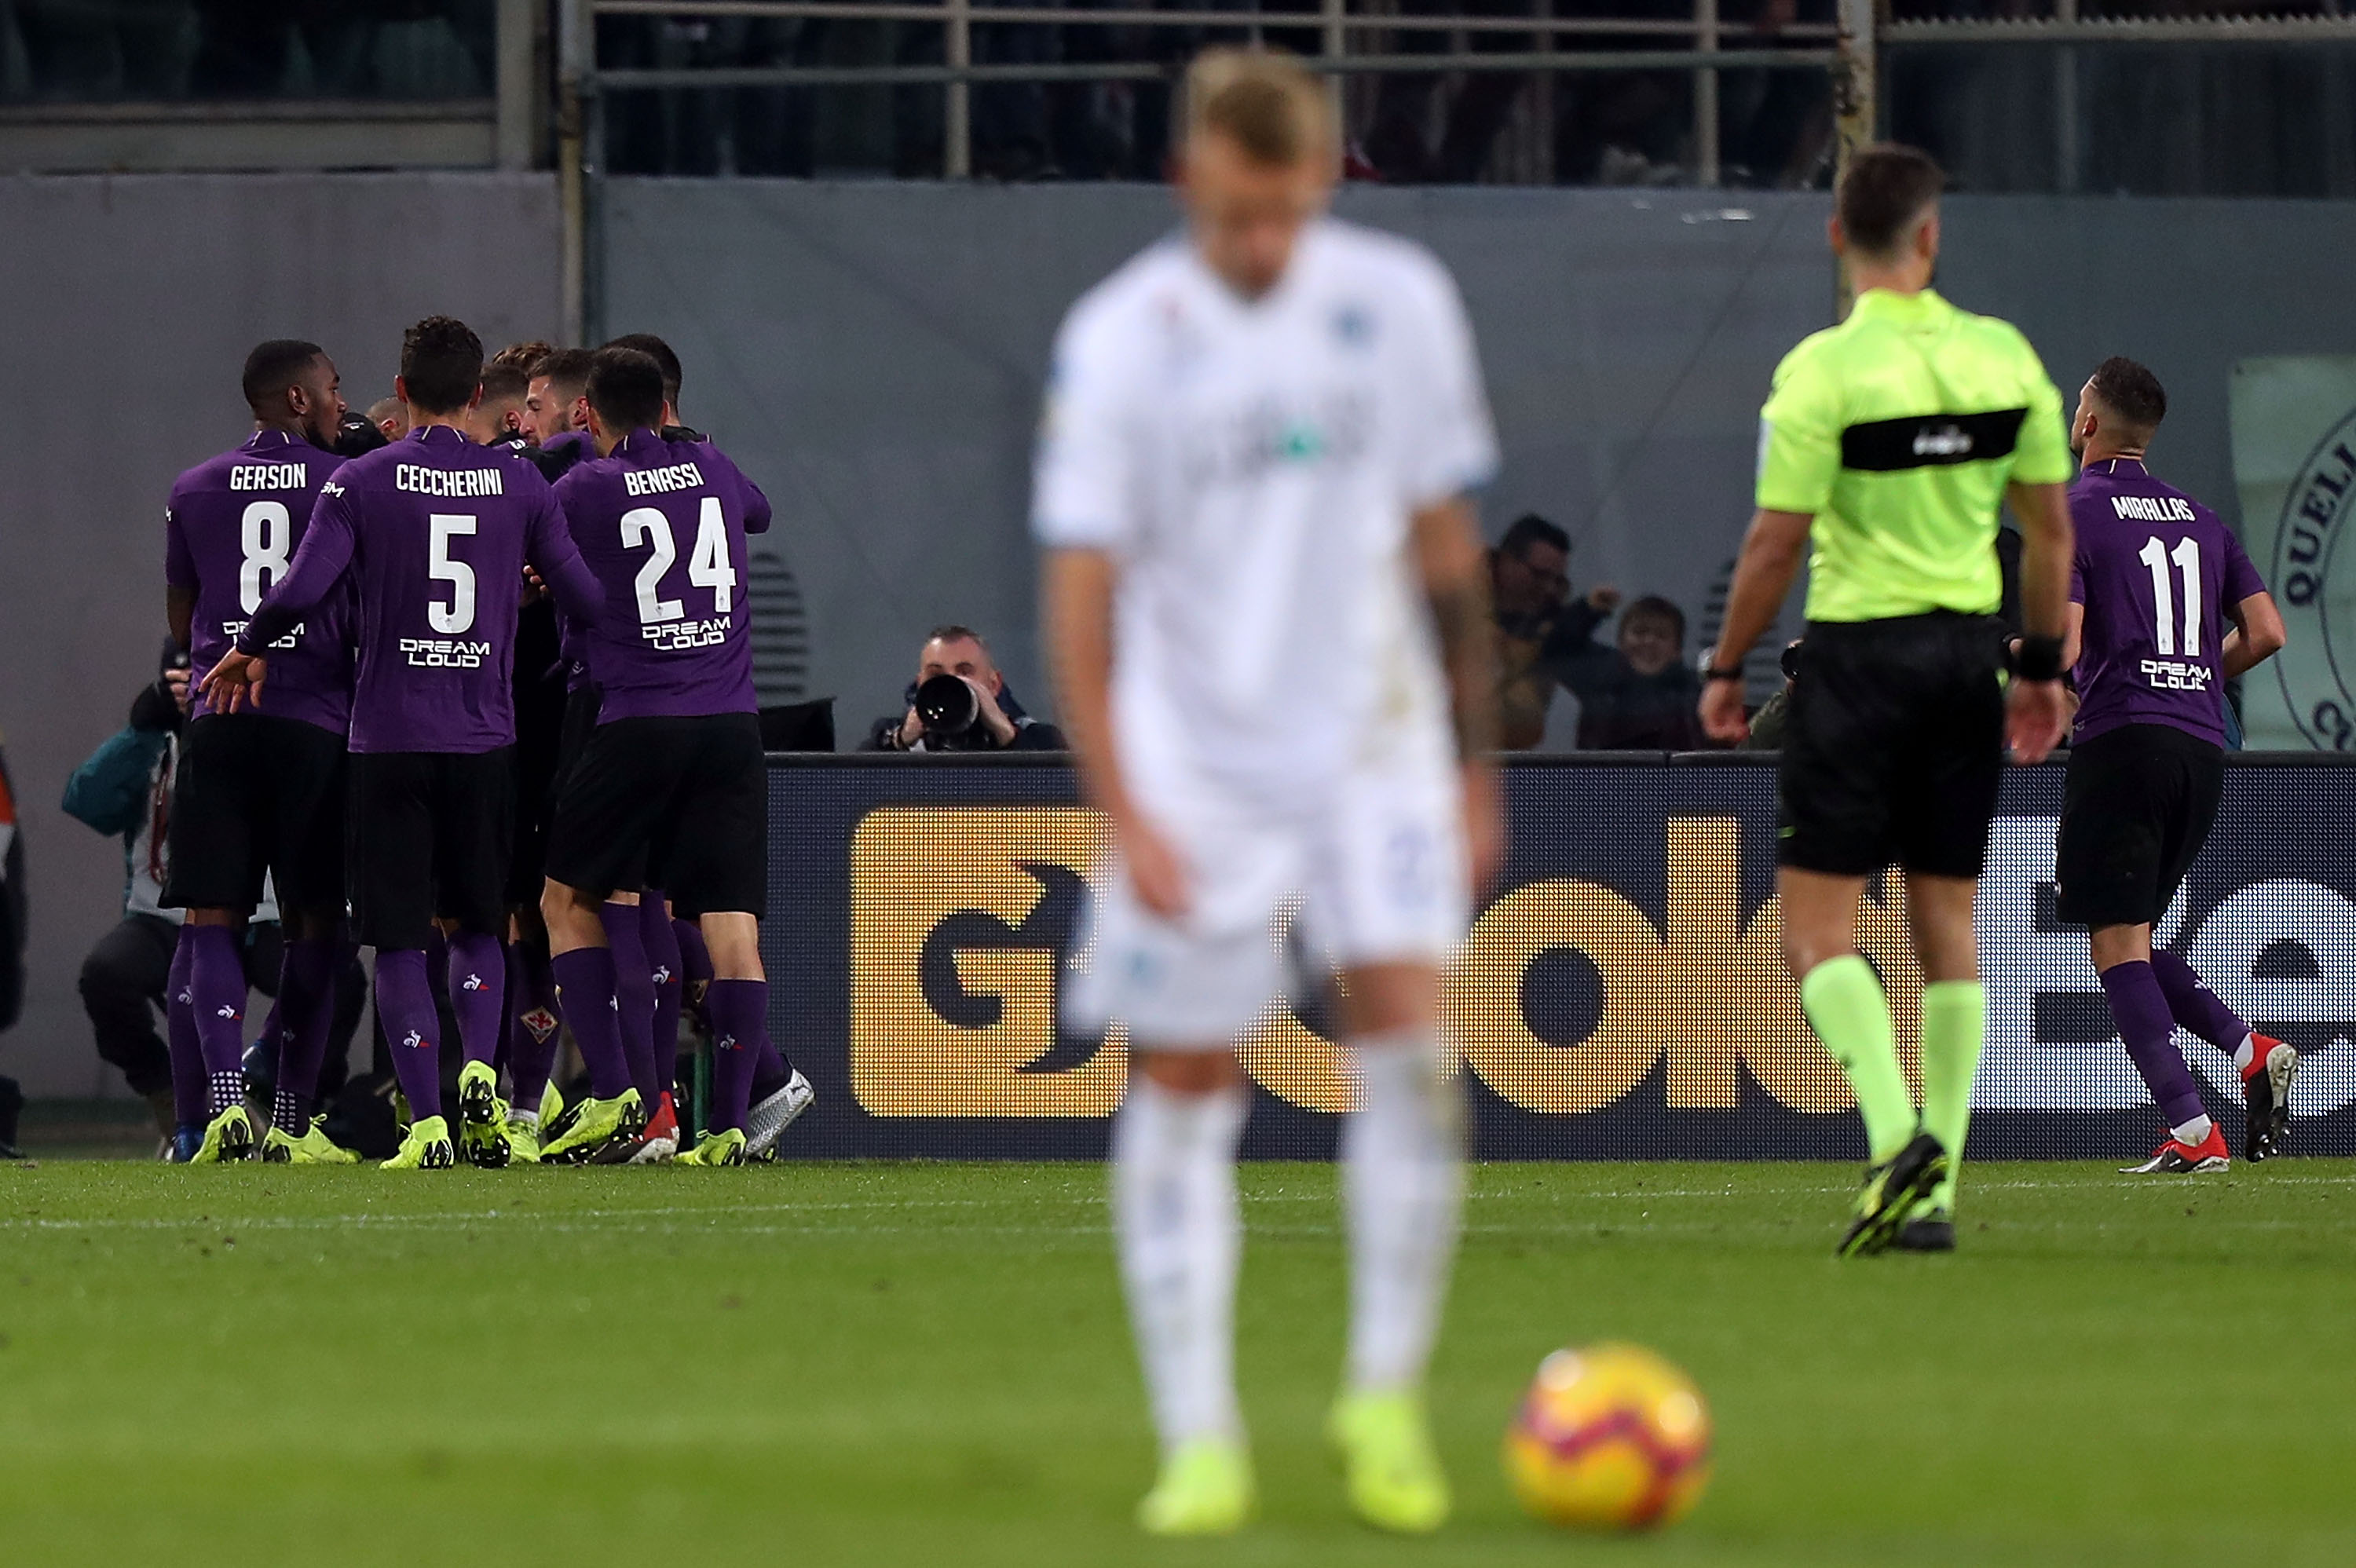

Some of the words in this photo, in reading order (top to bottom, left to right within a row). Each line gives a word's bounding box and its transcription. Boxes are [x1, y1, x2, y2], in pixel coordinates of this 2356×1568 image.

[230, 462, 306, 491] GERSON
[396, 463, 503, 497] CECCHERINI
[624, 462, 704, 496] BENASSI
[2110, 496, 2196, 521] MIRALLAS
[240, 501, 290, 616] 8
[620, 497, 737, 624] 24
[428, 514, 477, 634] 5
[2138, 535, 2201, 656] 11
[639, 616, 731, 639] DREAM
[653, 630, 725, 651] LOUD
[400, 638, 490, 656] DREAM
[408, 652, 480, 668] LOUD
[2141, 660, 2211, 681] DREAM
